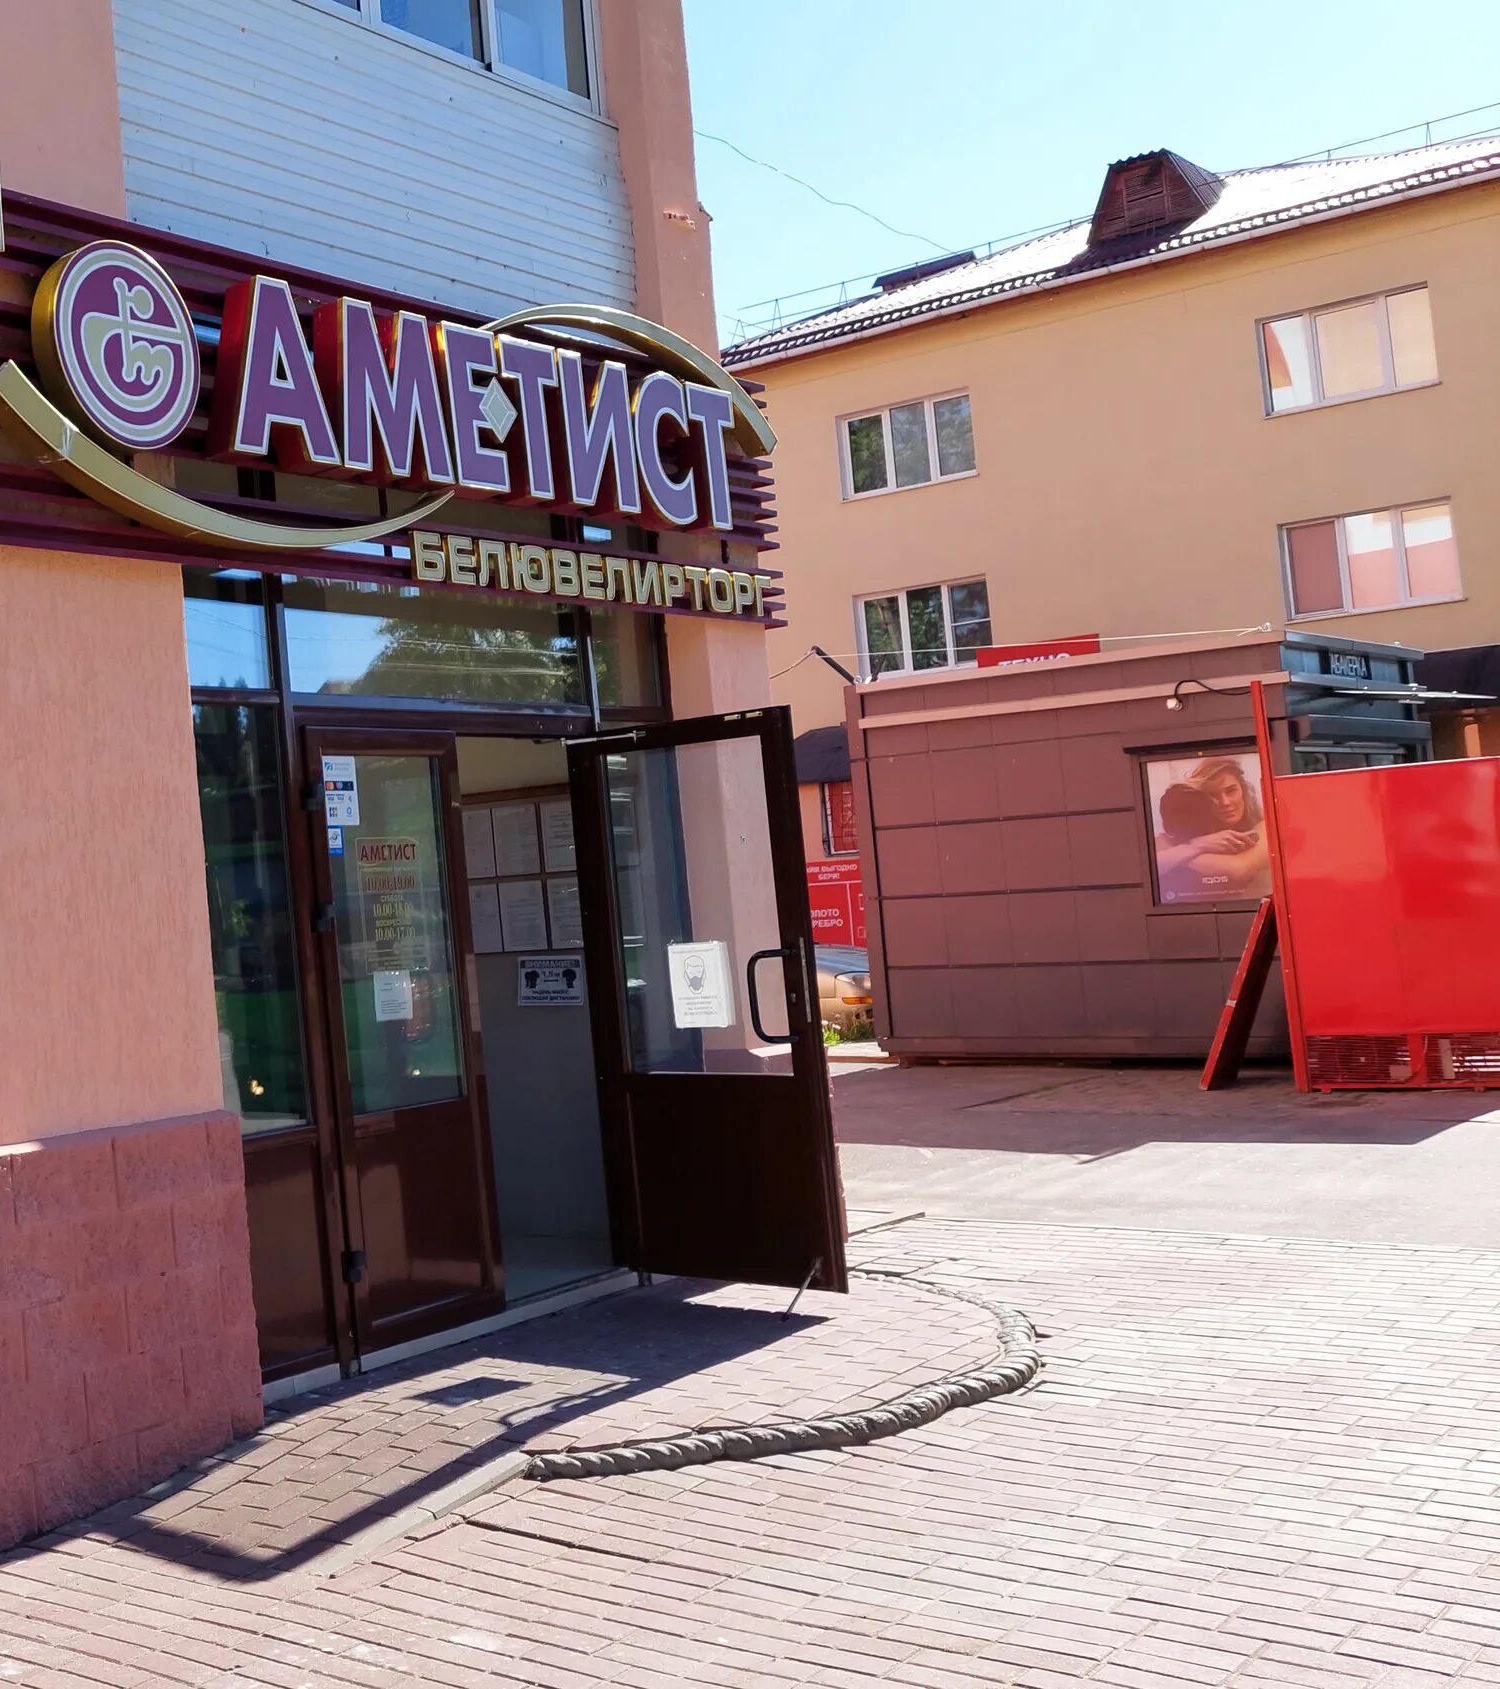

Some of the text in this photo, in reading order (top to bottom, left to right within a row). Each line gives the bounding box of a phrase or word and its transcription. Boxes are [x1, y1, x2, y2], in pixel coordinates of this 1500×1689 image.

[233, 274, 735, 531] АМЕТИСТ
[413, 530, 772, 617] БЕЛЮВЕЛИРТОРГ
[812, 919, 843, 928] РЕБРО
